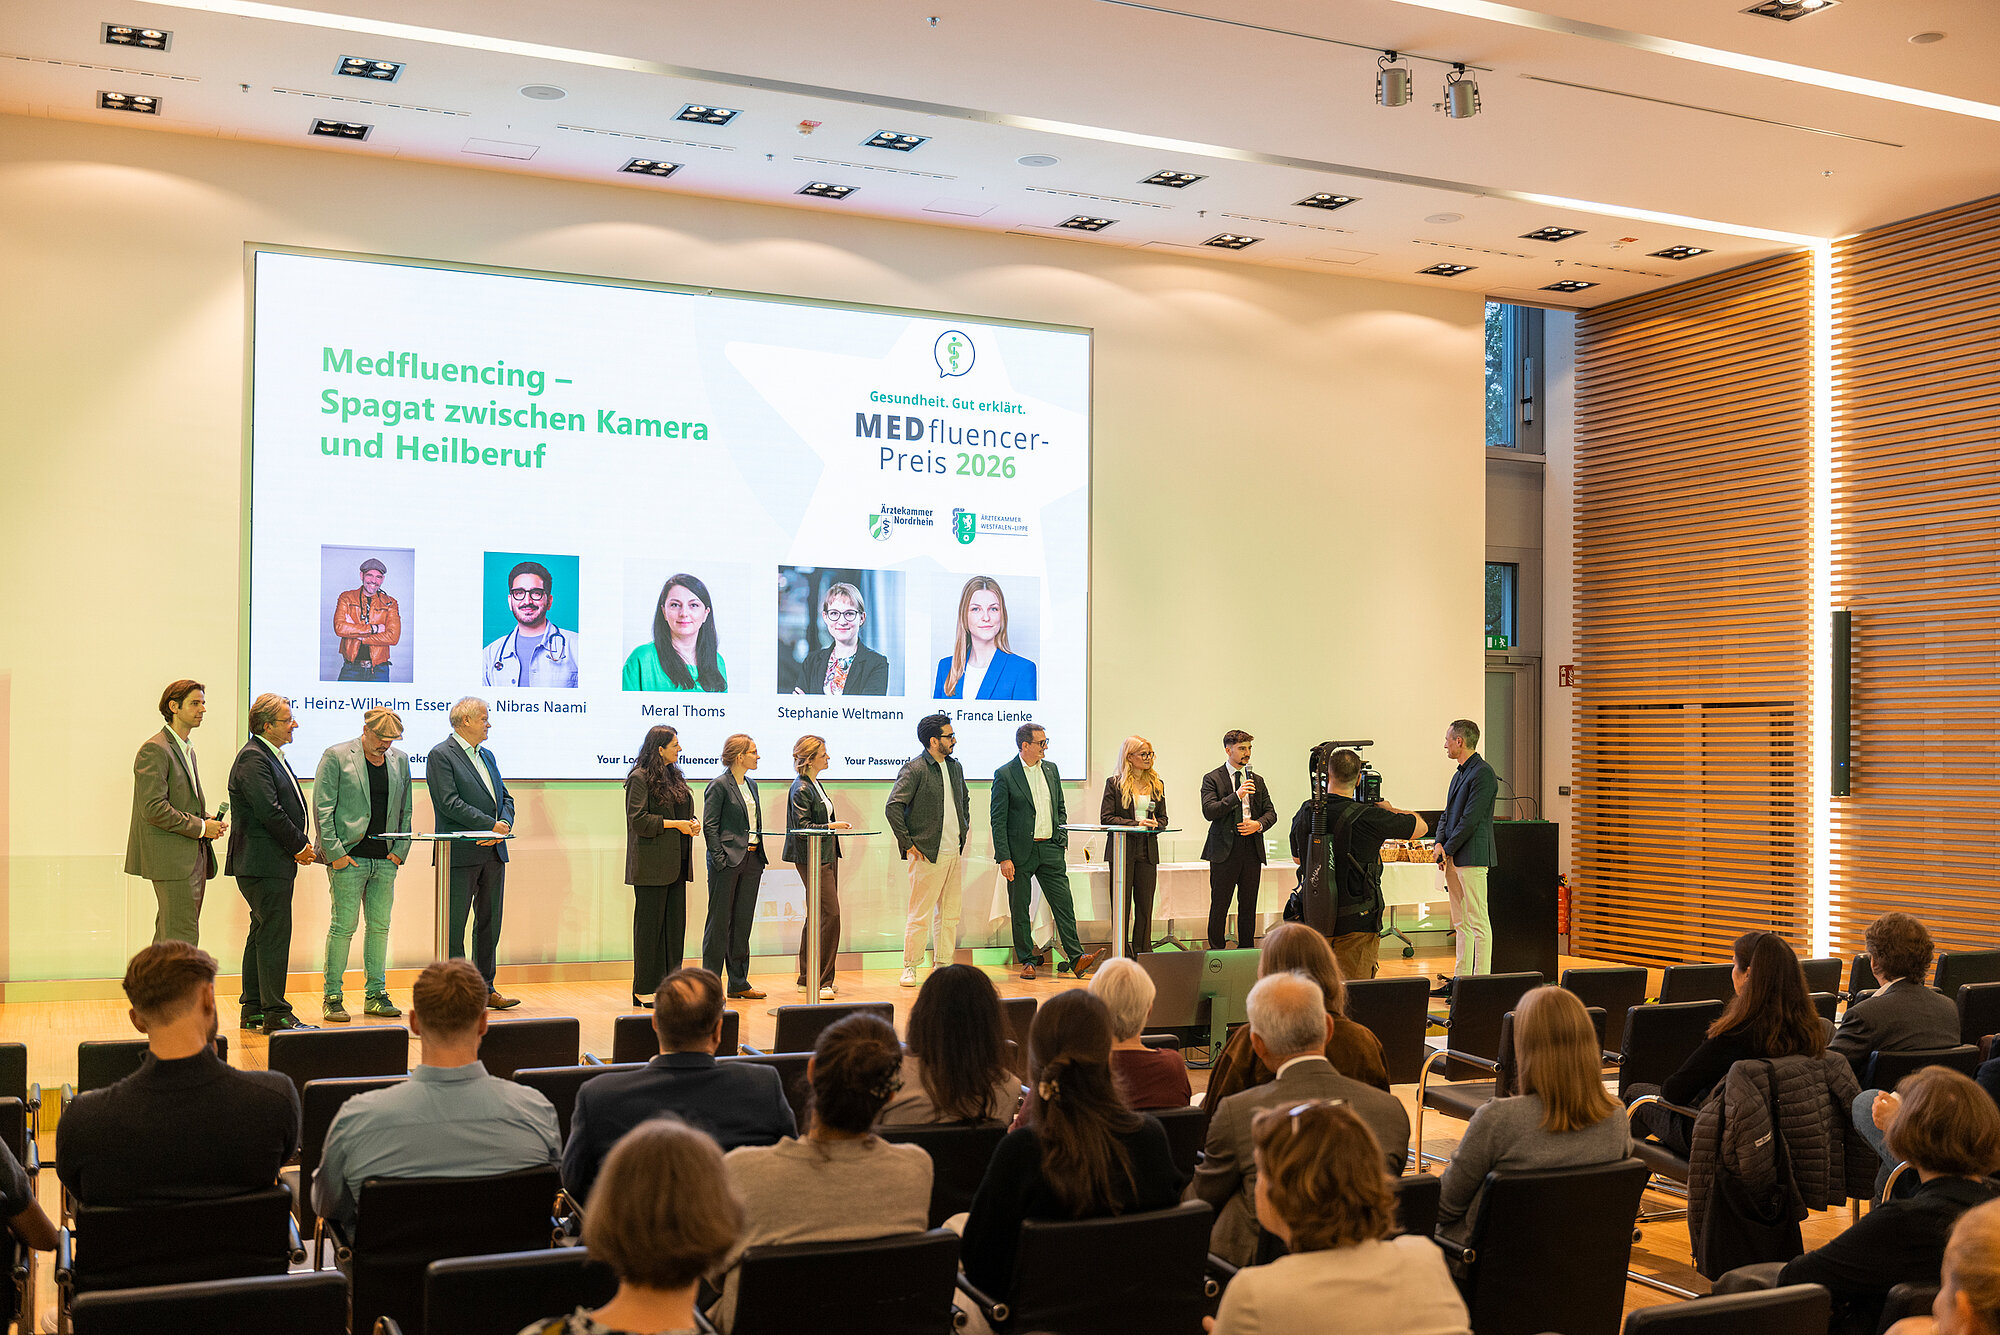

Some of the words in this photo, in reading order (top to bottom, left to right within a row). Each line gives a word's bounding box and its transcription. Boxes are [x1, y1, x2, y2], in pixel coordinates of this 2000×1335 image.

[322, 347, 545, 396] Medfluencing
[870, 391, 948, 408] Gesundheit.
[952, 398, 974, 410] Gut
[979, 401, 1025, 414] erklärt.
[322, 389, 434, 426] Spagat
[445, 400, 584, 431] zwischen
[598, 410, 707, 440] Kamera
[855, 412, 1049, 451] MEDfluencer-
[321, 433, 382, 458] und
[397, 435, 546, 468] Heilberuf
[881, 447, 946, 474] Preis
[957, 453, 1015, 478] 2026
[880, 504, 934, 516] Ärztekammer
[893, 516, 934, 526] Nordrhein
[304, 696, 410, 711] Heinz-Wilhelm
[416, 699, 452, 712] Esser
[497, 700, 539, 712] Nibras
[544, 701, 586, 713] Naami
[642, 704, 678, 716] Meral
[683, 705, 725, 717] Thoms
[778, 707, 838, 720] Stephanie
[842, 708, 903, 719] Weltmann
[957, 710, 993, 721] Franca
[998, 711, 1032, 721] Lienke
[597, 755, 620, 764] Your
[845, 757, 866, 765] Your
